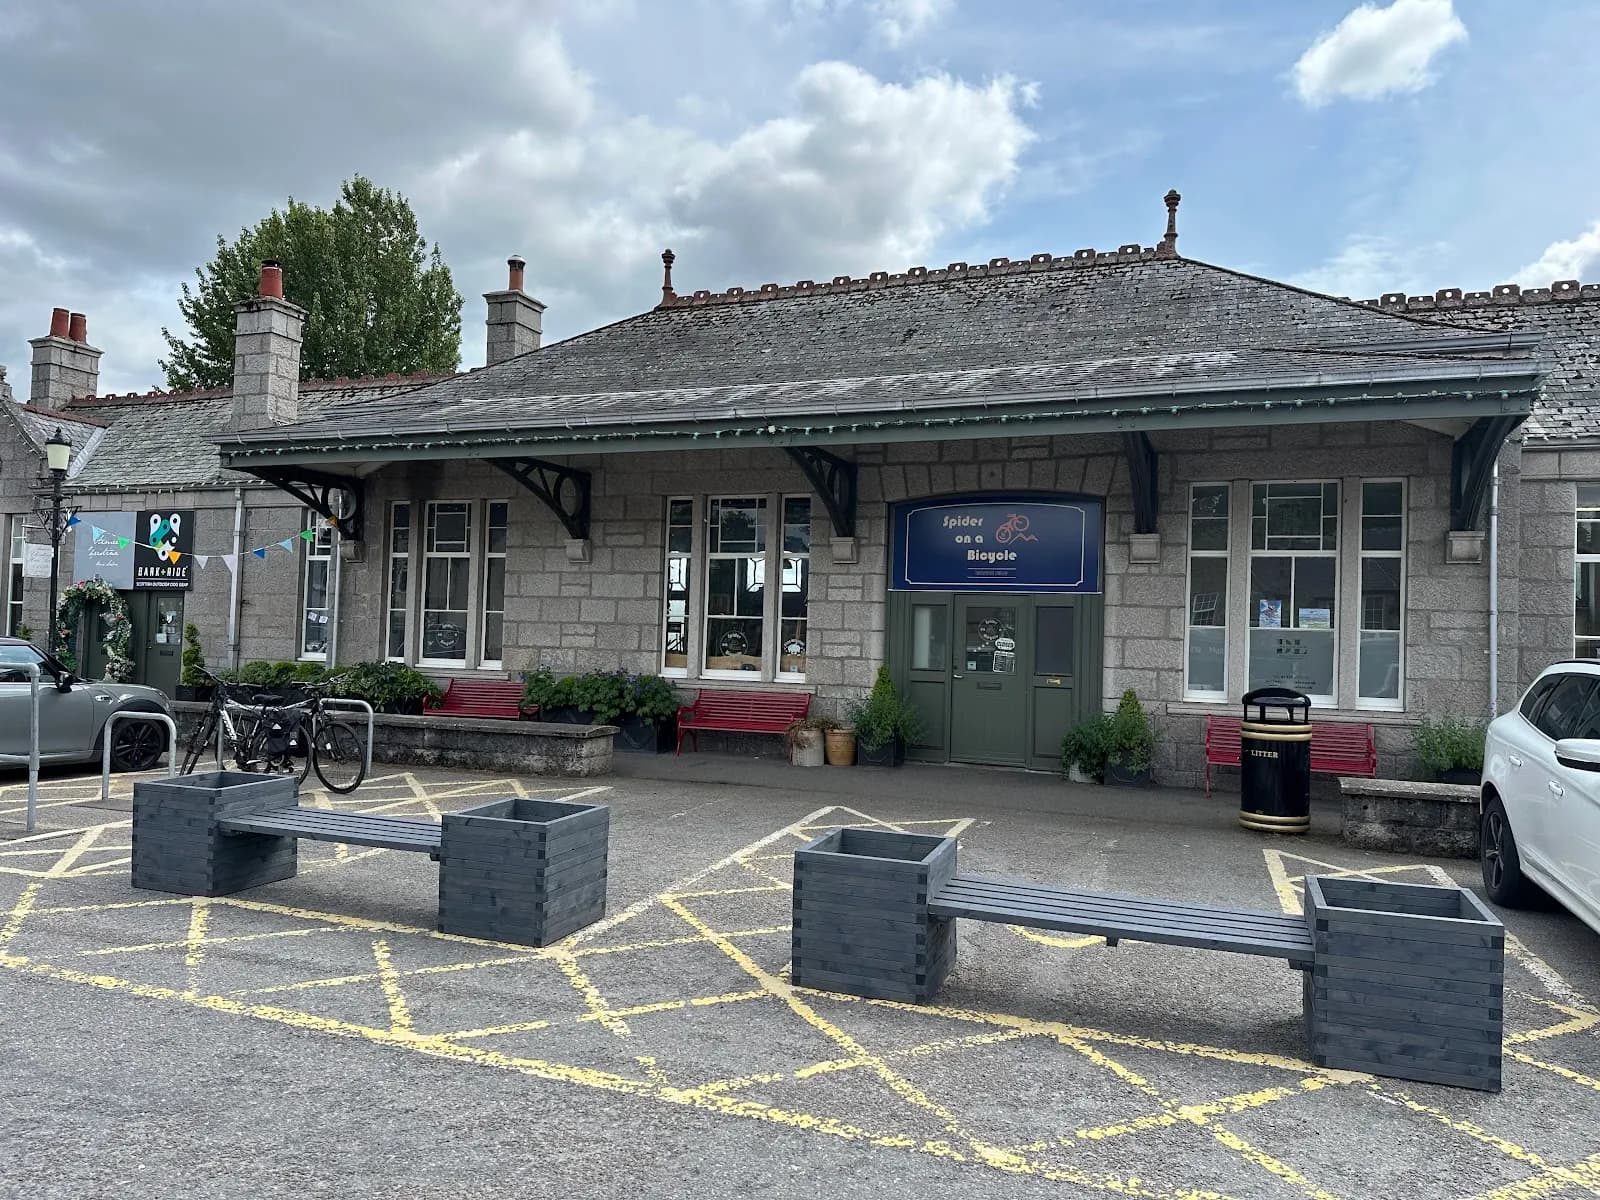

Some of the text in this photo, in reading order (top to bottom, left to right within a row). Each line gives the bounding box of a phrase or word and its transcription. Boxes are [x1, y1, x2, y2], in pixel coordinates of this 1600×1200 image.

[943, 515, 983, 529] Spider
[955, 535, 984, 544] on a
[967, 549, 1017, 564] Bicycle
[1251, 749, 1279, 759] LITTER
